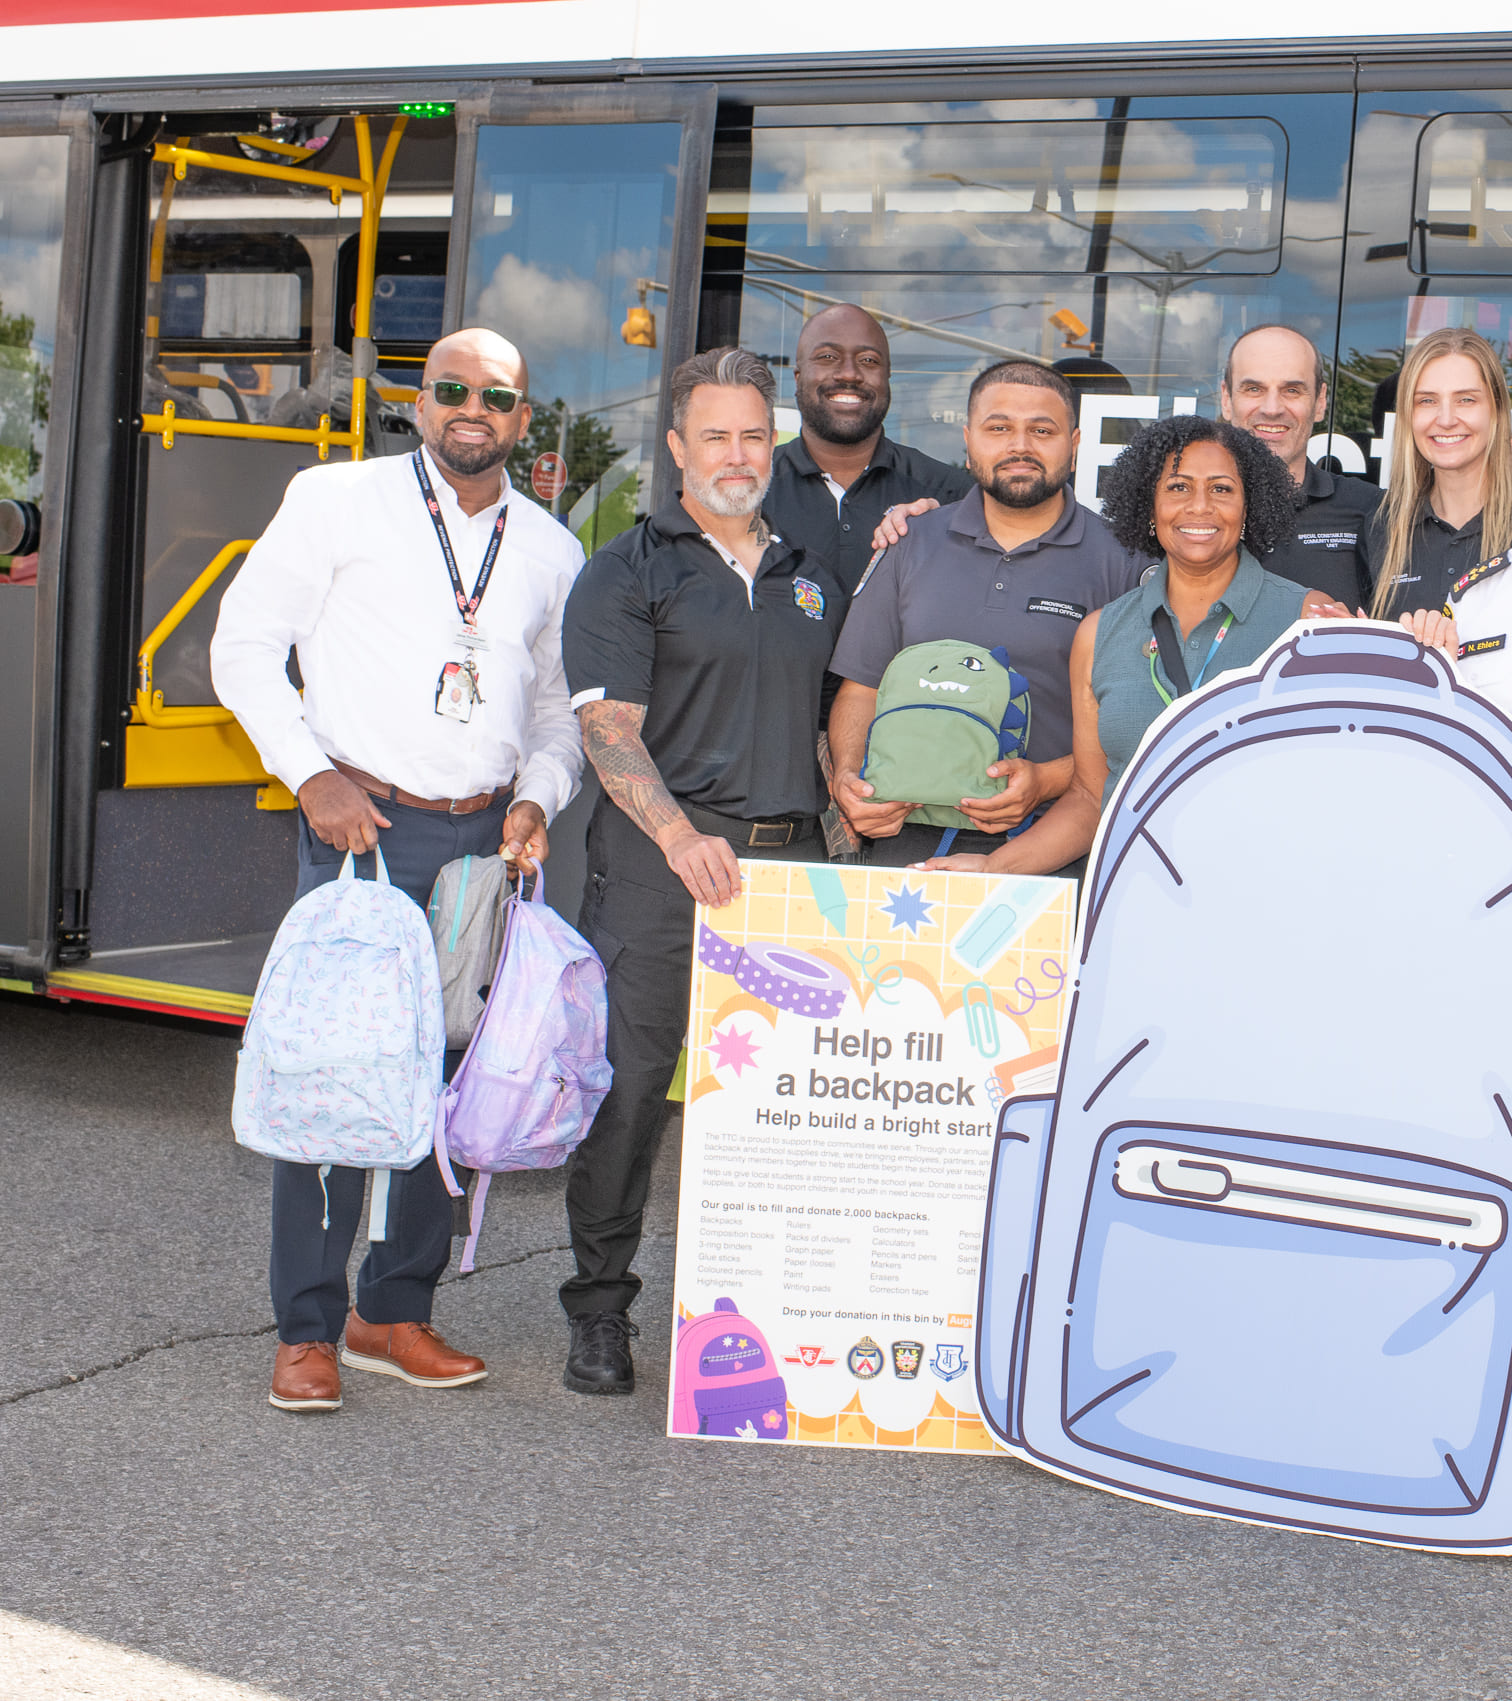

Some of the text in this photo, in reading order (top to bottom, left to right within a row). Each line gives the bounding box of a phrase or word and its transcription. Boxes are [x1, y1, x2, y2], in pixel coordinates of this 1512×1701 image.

[1041, 601, 1073, 611] PROVINCIAL
[1059, 609, 1082, 619] OFFICER
[1477, 640, 1500, 650] Ehlers
[813, 1027, 943, 1067] Help fill
[776, 1068, 974, 1110] a backpack
[755, 1108, 992, 1138] Help build a bright start
[964, 1182, 988, 1192] backp
[701, 1200, 720, 1209] Our
[722, 1202, 744, 1212] goal
[747, 1203, 755, 1211] is
[758, 1203, 768, 1212] to
[771, 1204, 783, 1213] fill
[786, 1206, 804, 1214] and
[807, 1206, 841, 1216] donate
[874, 1210, 930, 1221] backpacks.
[700, 1216, 742, 1226] Backpacks
[699, 1228, 775, 1239] Composition books
[873, 1226, 911, 1236] Geometry
[821, 1235, 851, 1243] dividers
[872, 1238, 915, 1246] Calculators
[699, 1241, 752, 1250] 3-ring binders
[785, 1246, 809, 1255] Graph
[872, 1250, 899, 1258] Pencils
[785, 1258, 807, 1267] Paper
[871, 1260, 902, 1269] Markers
[697, 1265, 733, 1274] Coloured
[870, 1272, 899, 1281] Erasers
[697, 1277, 743, 1287] Highlighters
[783, 1282, 832, 1293] Writing pads
[869, 1285, 928, 1296] Correction tape
[782, 1307, 806, 1318] Drop
[834, 1310, 878, 1319] donation
[881, 1312, 889, 1320] in
[893, 1312, 911, 1321] this
[914, 1313, 929, 1322] bin
[932, 1314, 944, 1325] by
